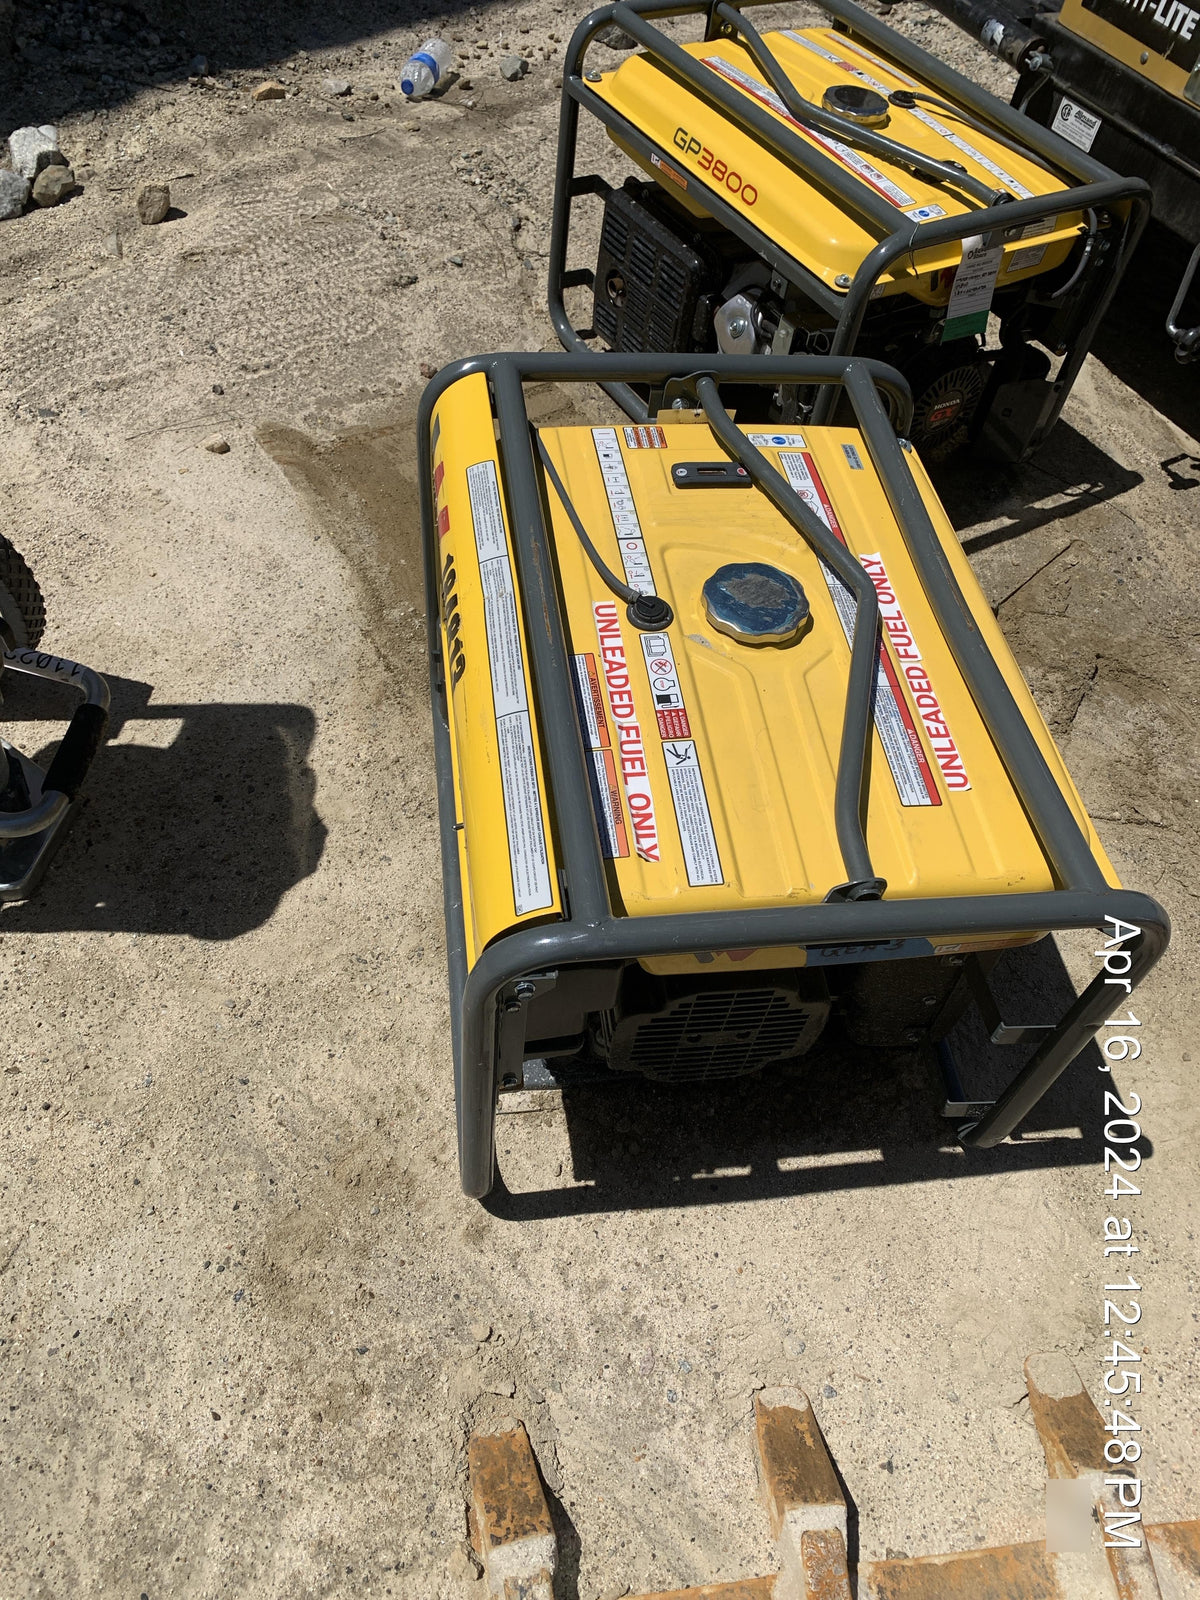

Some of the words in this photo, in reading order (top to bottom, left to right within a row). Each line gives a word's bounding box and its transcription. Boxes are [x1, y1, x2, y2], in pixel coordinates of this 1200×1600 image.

[673, 127, 758, 206] GP3800
[861, 557, 896, 605] ONLY
[594, 604, 635, 719] UNLEADED
[886, 610, 919, 659] FUEL
[589, 677, 606, 728] AVERTISSEMENT
[905, 666, 968, 788] UNLEADED
[618, 724, 648, 786] FUEL
[908, 733, 926, 763] DANGER
[609, 790, 622, 825] WARNING
[628, 793, 660, 862] ONLY
